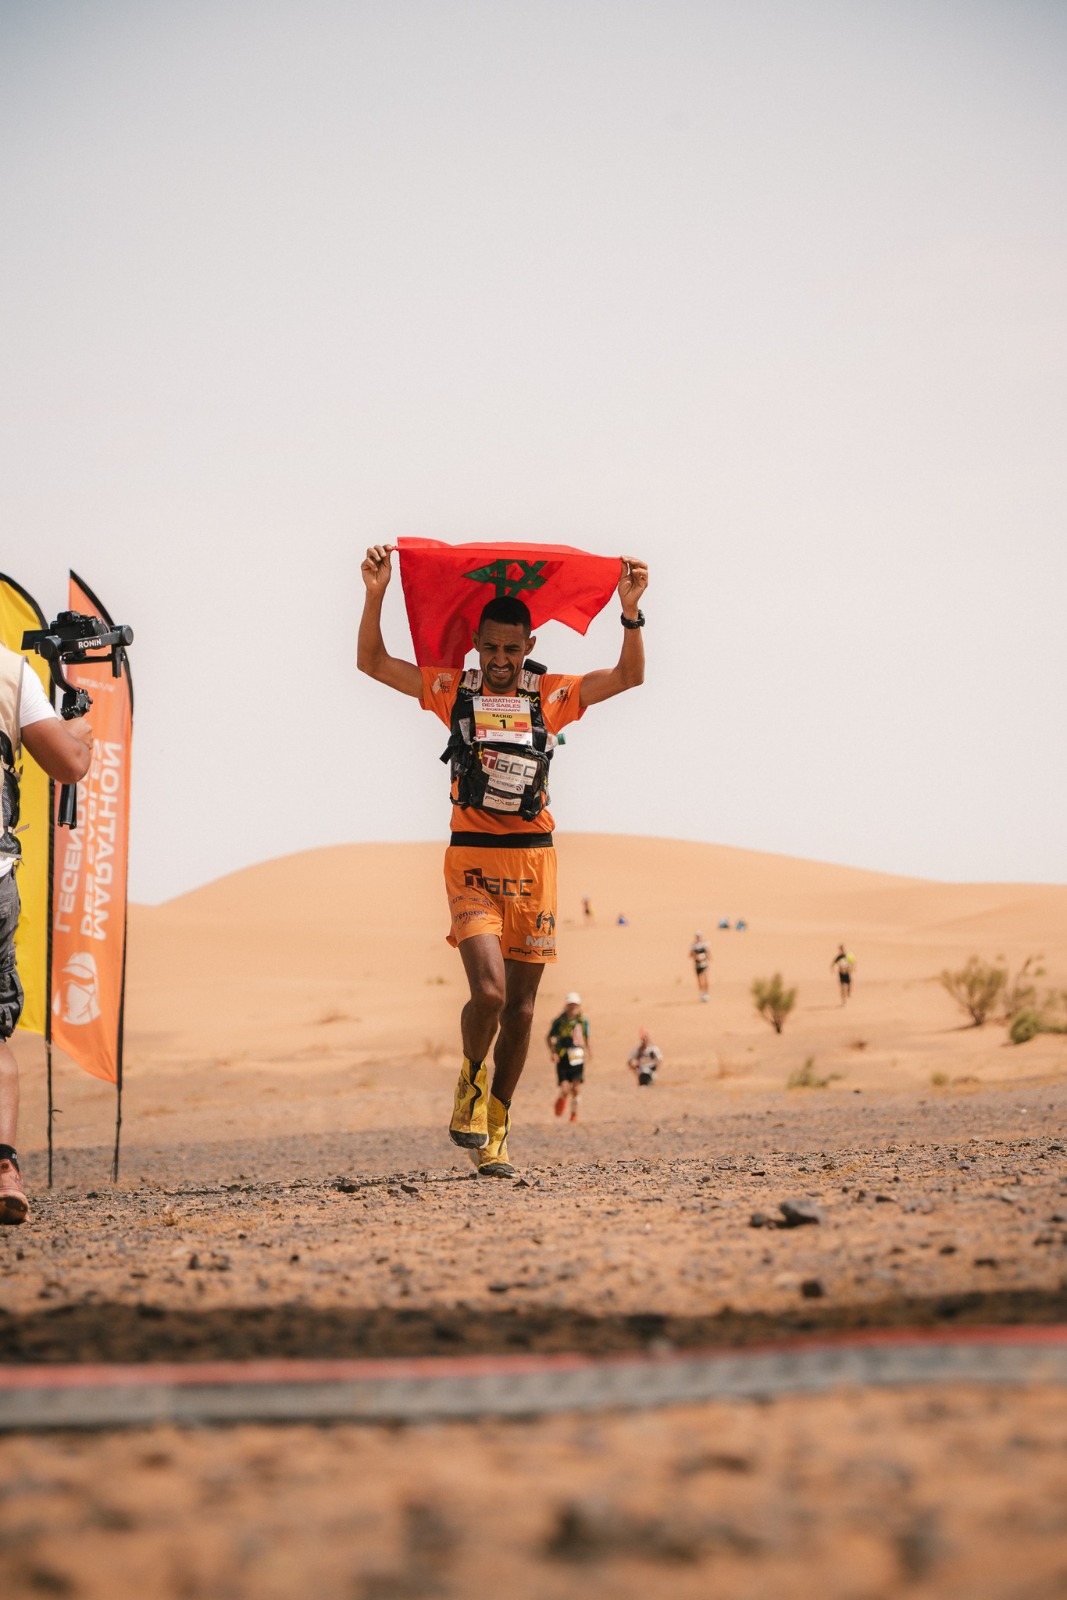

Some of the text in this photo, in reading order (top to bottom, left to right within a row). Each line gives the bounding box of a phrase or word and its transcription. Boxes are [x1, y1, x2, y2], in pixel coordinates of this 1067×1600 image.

[78, 638, 102, 649] RONIN
[499, 719, 507, 729] 1
[482, 750, 536, 779] TGCC
[464, 868, 534, 896] TGCC
[526, 935, 556, 948] MD
